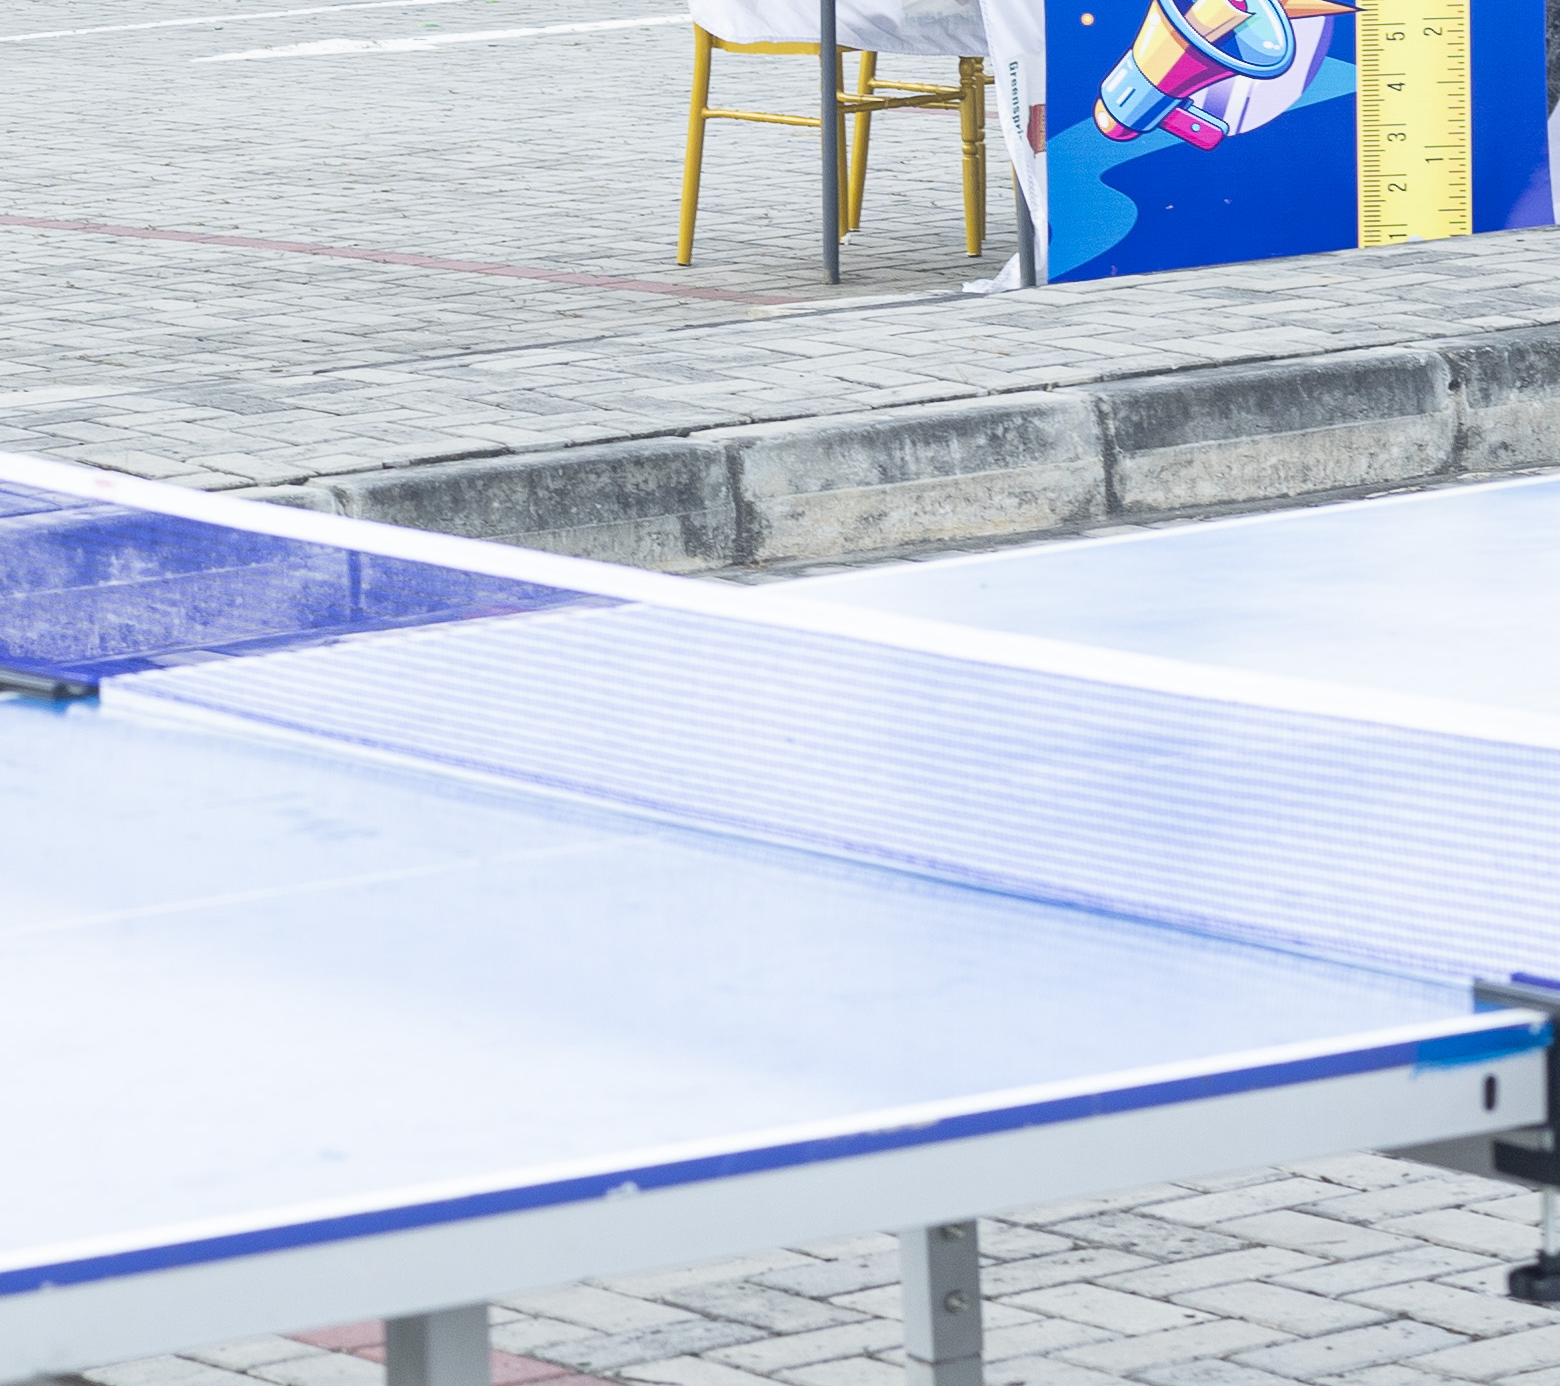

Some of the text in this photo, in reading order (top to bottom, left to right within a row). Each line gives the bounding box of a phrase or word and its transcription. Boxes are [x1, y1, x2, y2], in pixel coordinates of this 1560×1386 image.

[1386, 31, 1405, 41] 5
[1423, 26, 1443, 36] 2
[1387, 82, 1406, 92] 4
[1387, 132, 1407, 142] 3
[1388, 182, 1407, 192] 2
